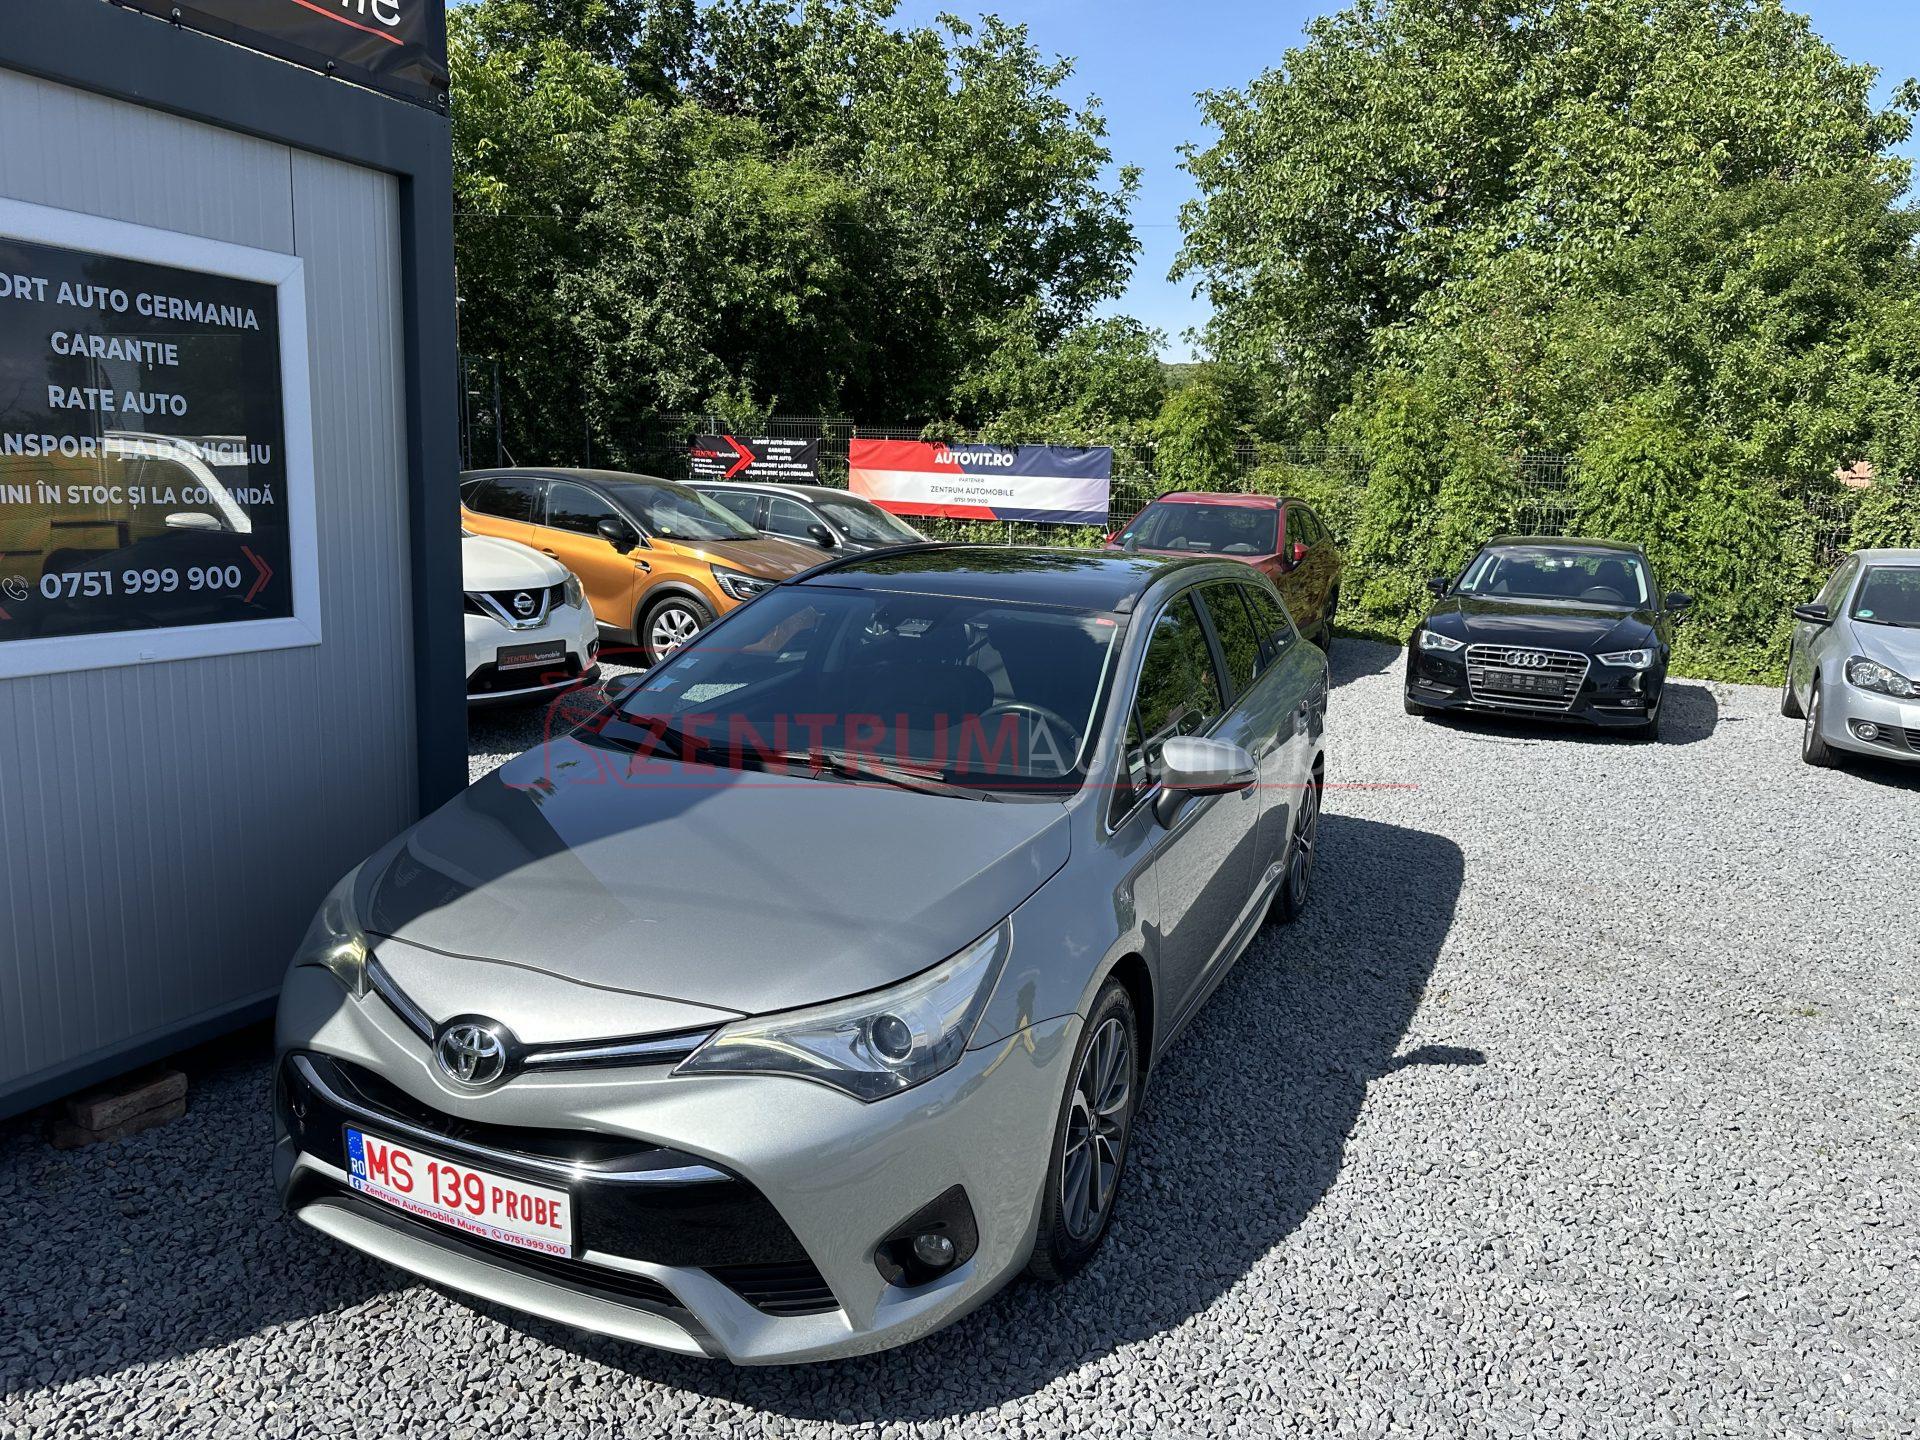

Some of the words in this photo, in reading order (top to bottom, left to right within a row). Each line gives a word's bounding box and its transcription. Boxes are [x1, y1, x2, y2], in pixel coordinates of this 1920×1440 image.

[56, 282, 129, 313] AUTO
[135, 292, 260, 331] GERMANIA
[50, 331, 179, 370] GARANȚIE
[48, 384, 116, 412] RATE
[121, 391, 188, 417] AUTO
[0, 432, 108, 460] NSPORT
[120, 438, 151, 461] LA
[934, 451, 1014, 467] AUTOVIT.RO
[36, 480, 61, 504] ÎN
[67, 485, 122, 505] STOC
[128, 485, 147, 511] ȘI
[151, 486, 177, 504] LA
[930, 485, 964, 494] ZENTRUM
[965, 487, 1015, 497] AUTOMOBILE
[39, 570, 113, 599] 0751
[122, 567, 180, 594] 999
[187, 565, 242, 591] 900
[350, 1157, 366, 1176] RO
[365, 1140, 414, 1194] MS
[427, 1161, 486, 1216] 139
[492, 1185, 563, 1230] PROBE
[365, 1183, 401, 1206] Zentrum
[402, 1200, 456, 1225] Automobile
[457, 1218, 487, 1236] Mures
[503, 1233, 567, 1255] 0751.999.900
